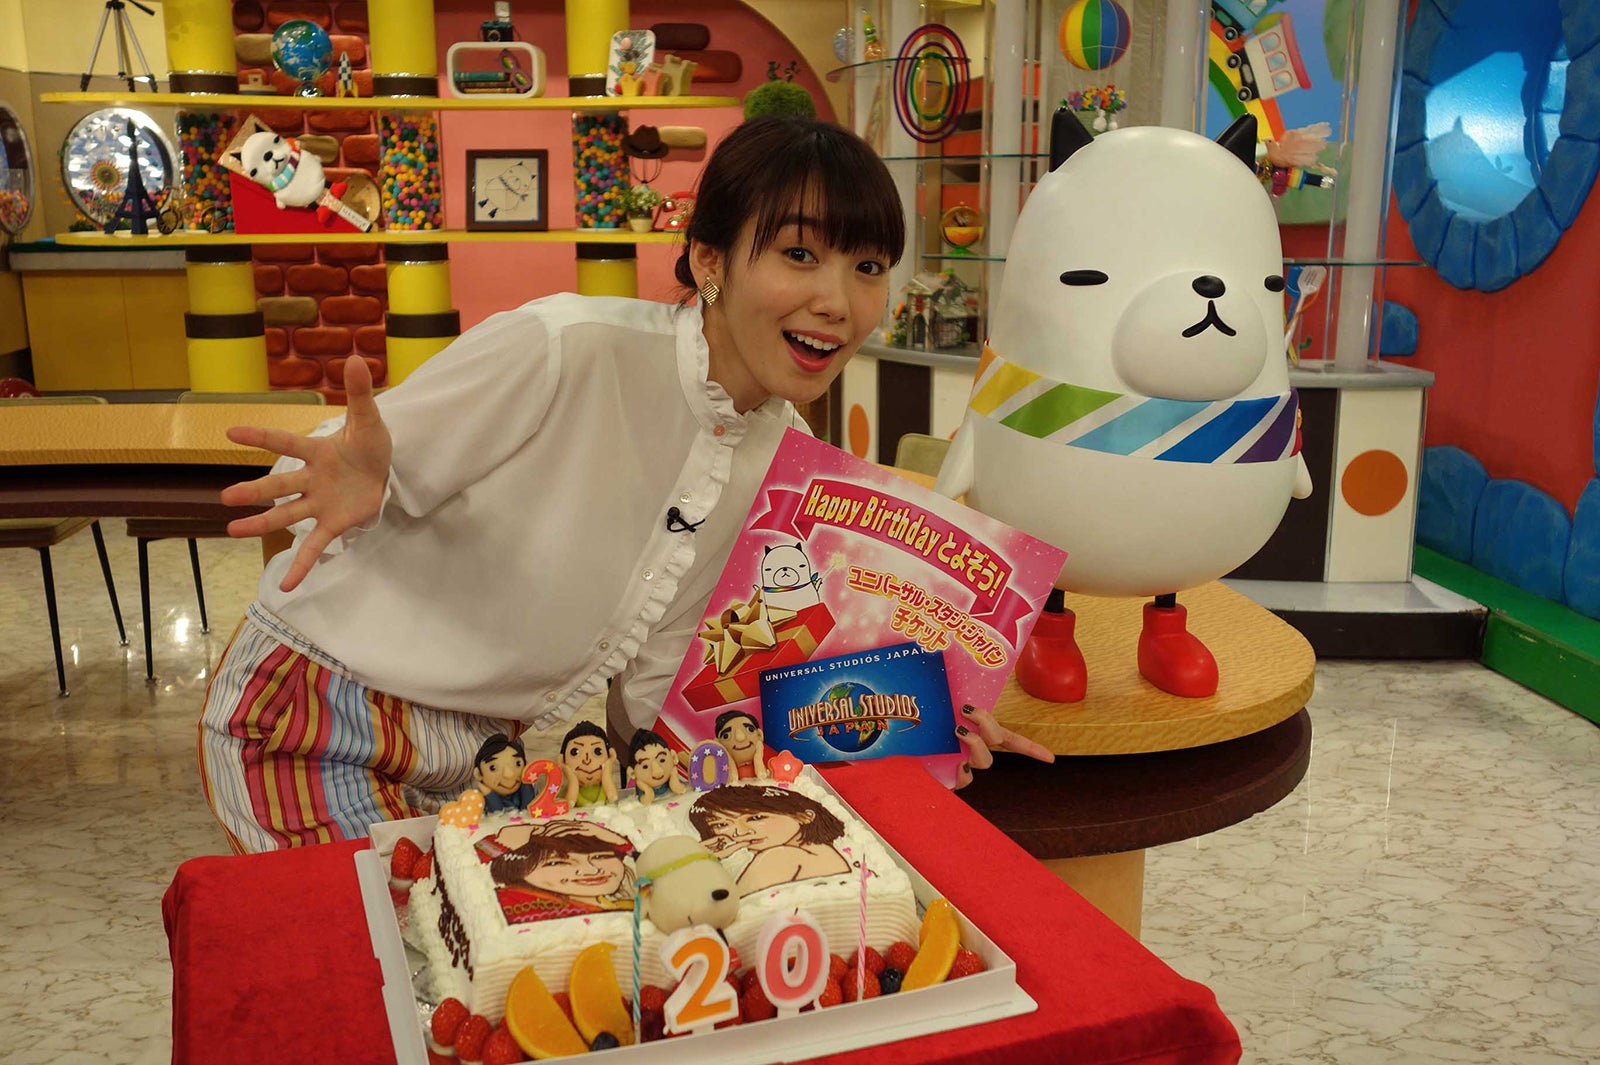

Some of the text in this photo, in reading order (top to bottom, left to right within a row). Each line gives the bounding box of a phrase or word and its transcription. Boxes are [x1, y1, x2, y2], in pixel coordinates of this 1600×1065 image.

[804, 484, 861, 526] Happy
[860, 496, 940, 556] Birthday
[894, 607, 949, 651] チケット
[765, 665, 825, 682] UNIVERSAL
[829, 655, 881, 671] STUDIOS
[788, 694, 921, 731] UNIVERSAL STUDIOS
[817, 719, 889, 737] JAPAN
